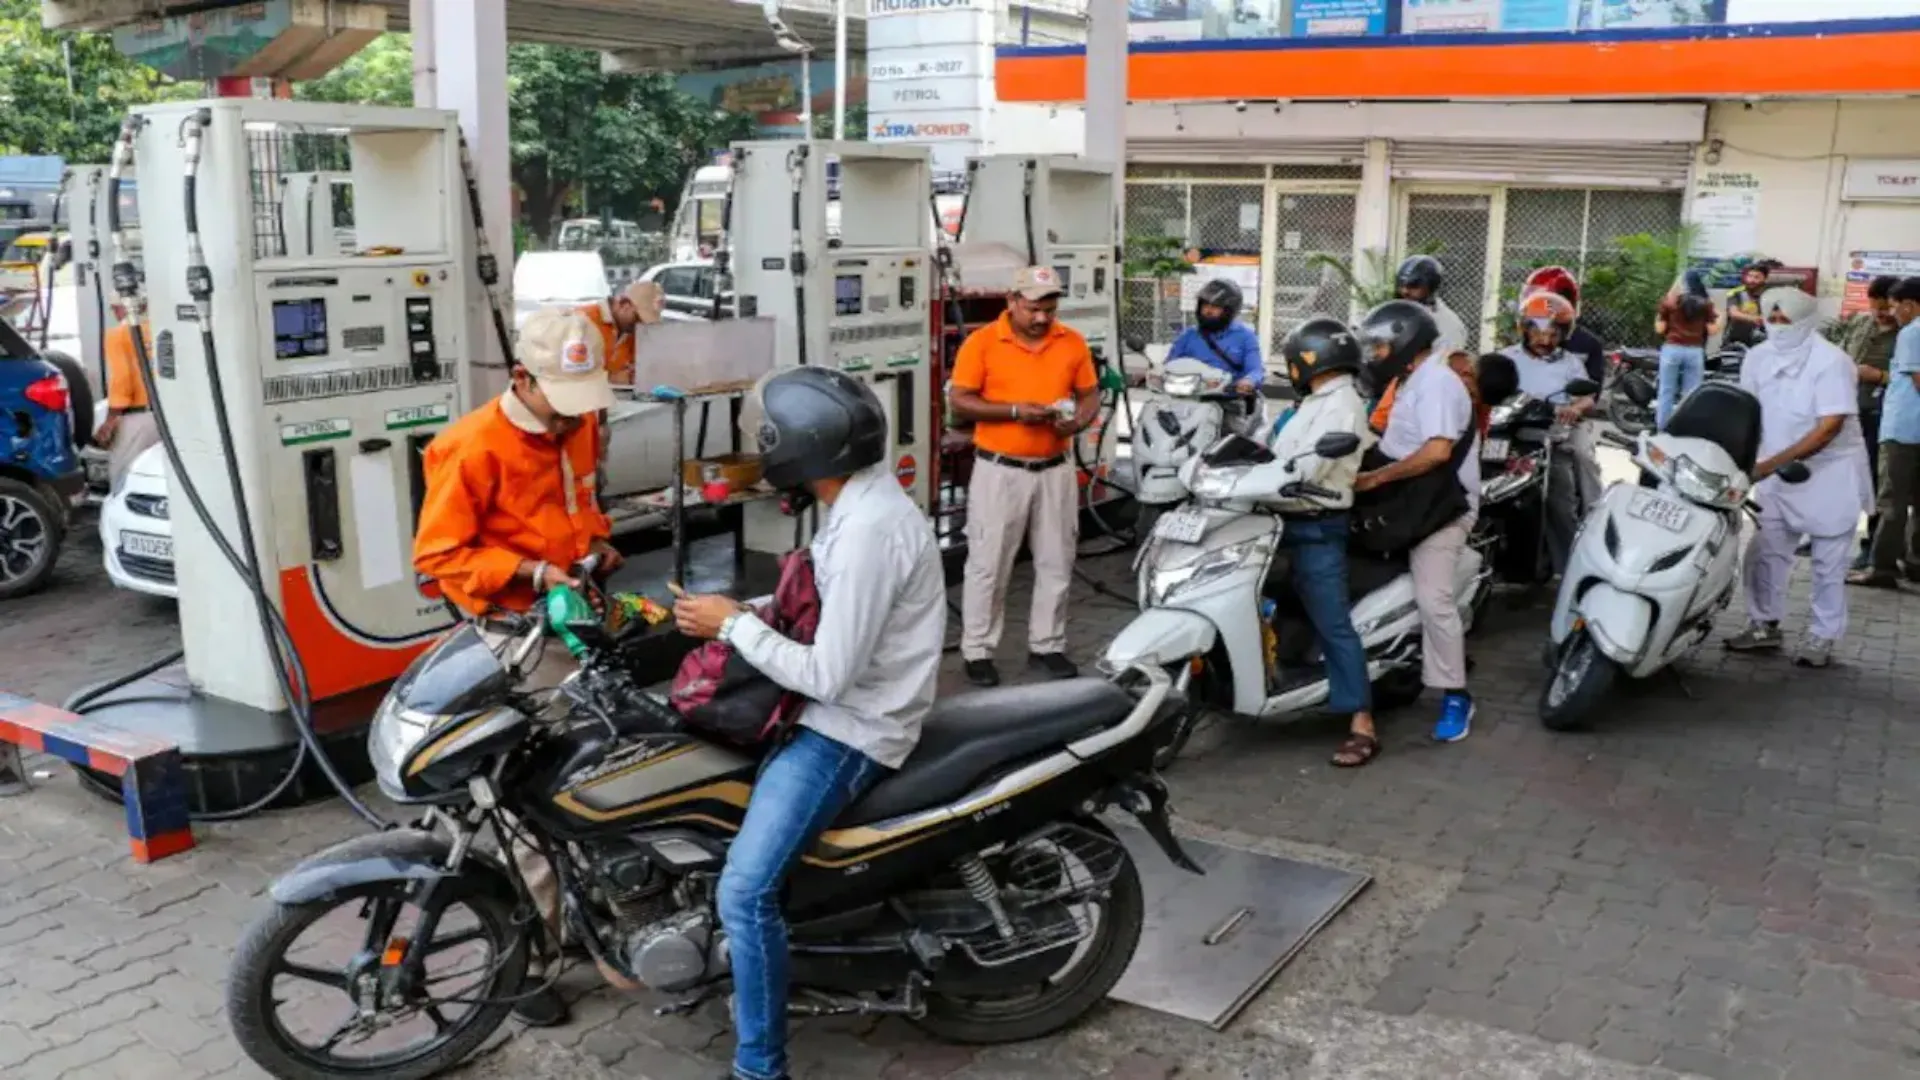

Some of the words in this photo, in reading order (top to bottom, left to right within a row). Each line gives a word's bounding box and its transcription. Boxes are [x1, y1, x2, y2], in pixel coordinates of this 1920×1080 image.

[870, 0, 970, 13] Indian
[893, 88, 940, 101] PETROL
[1877, 174, 1918, 186] TOILET
[294, 421, 336, 437] PETROL
